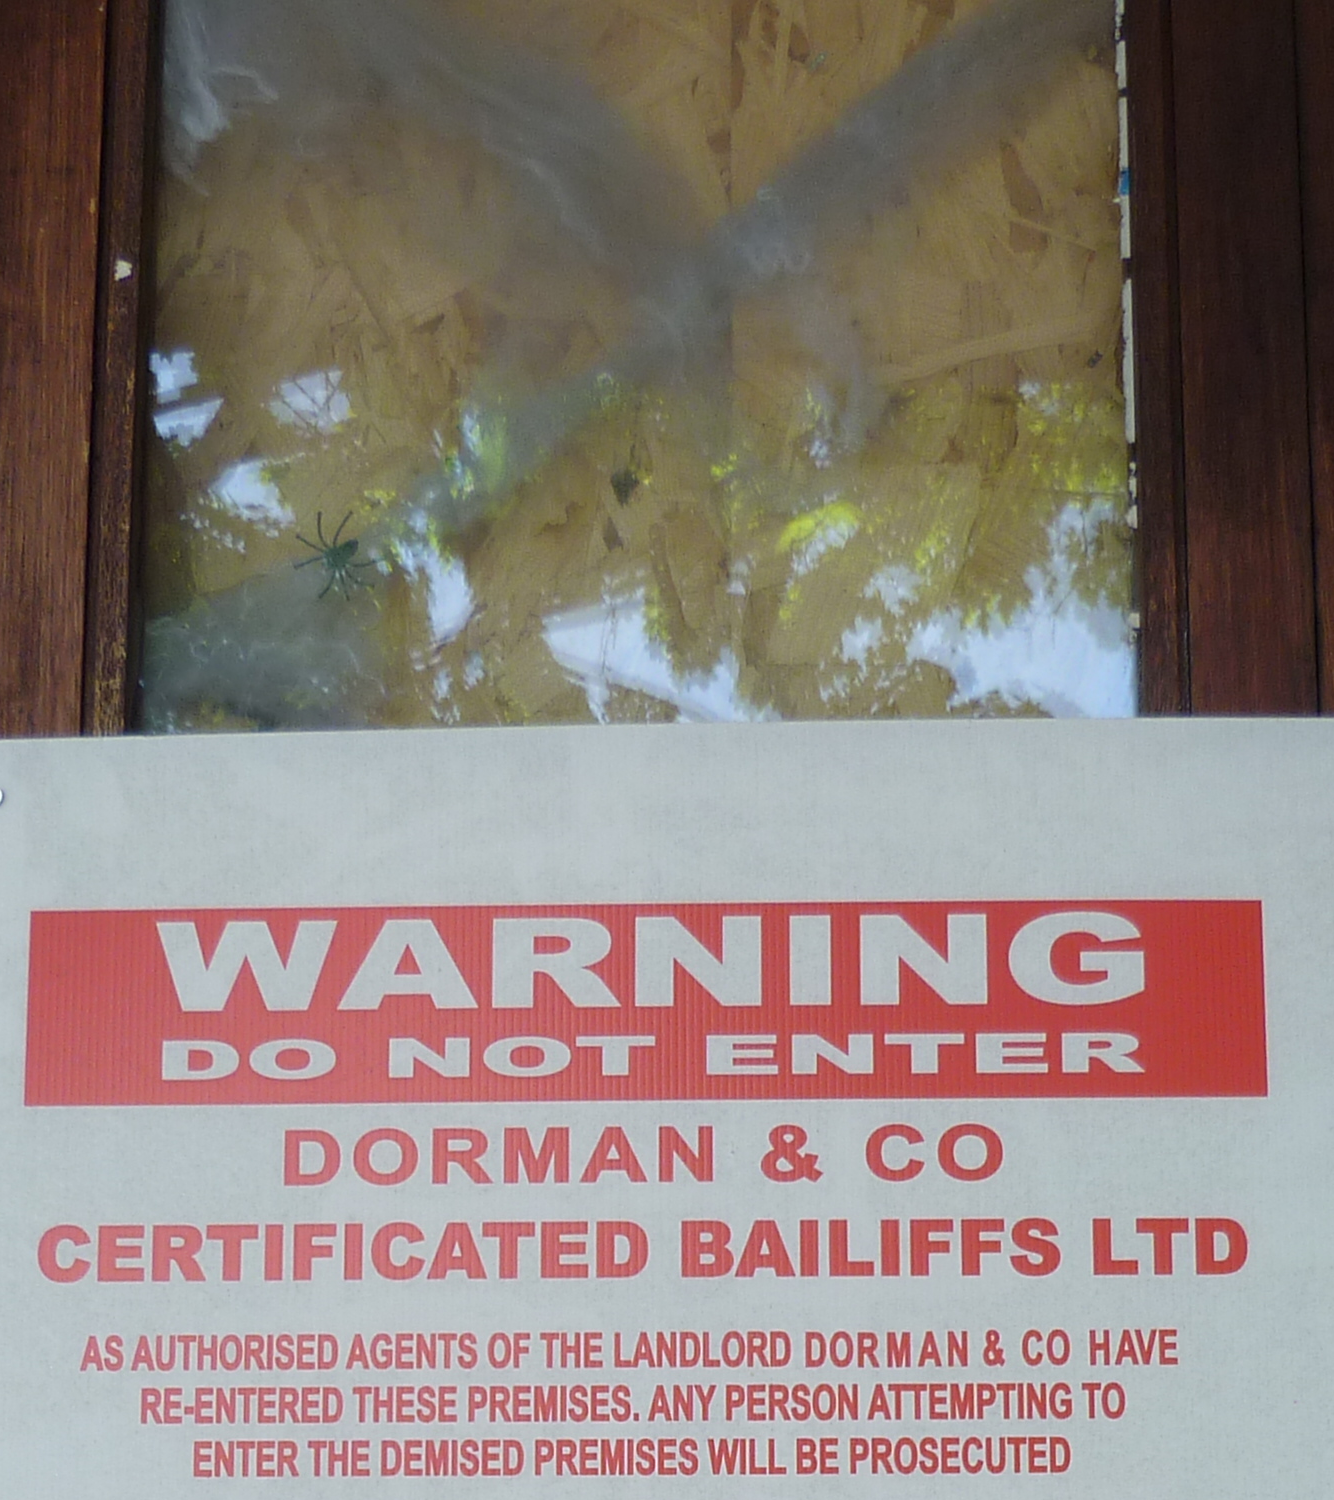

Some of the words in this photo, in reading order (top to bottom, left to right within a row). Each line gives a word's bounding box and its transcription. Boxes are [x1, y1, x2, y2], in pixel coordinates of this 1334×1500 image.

[156, 910, 1145, 1012] WARNING
[161, 1038, 337, 1081] DO
[388, 1035, 656, 1078] NOT
[706, 1031, 1144, 1075] ENTER
[286, 1127, 713, 1184] DORMAN
[762, 1126, 821, 1181] &
[867, 1124, 1003, 1181] CO
[39, 1222, 647, 1281] CERTIFICATED
[683, 1219, 1060, 1276] BAILIFFS
[1094, 1219, 1247, 1274] LTD
[84, 1337, 122, 1369] AS
[134, 1336, 337, 1369] AUTHORISED
[348, 1334, 477, 1368] AGENTS
[489, 1334, 529, 1367] OF
[542, 1333, 602, 1367] THE
[616, 1332, 791, 1367] LANDLORD
[807, 1332, 968, 1366] DORMAN
[985, 1331, 1004, 1365] &
[1024, 1330, 1069, 1365] CO
[1091, 1330, 1177, 1364] HAVE
[143, 1388, 342, 1422] RE-ENTERED
[355, 1387, 456, 1421] THESE
[470, 1386, 640, 1421] PREMISES.
[650, 1386, 715, 1420] ANY
[727, 1385, 858, 1420] PERSON
[870, 1383, 1072, 1419] ATTEMPTING
[1083, 1383, 1125, 1418] TO
[195, 1442, 297, 1476] ENTER
[310, 1441, 369, 1475] THE
[383, 1441, 523, 1475] DEMISED
[537, 1439, 698, 1474] PREMISES
[709, 1440, 786, 1474] WILL
[798, 1439, 838, 1473] BE
[851, 1437, 1070, 1473] PROSECUTED
